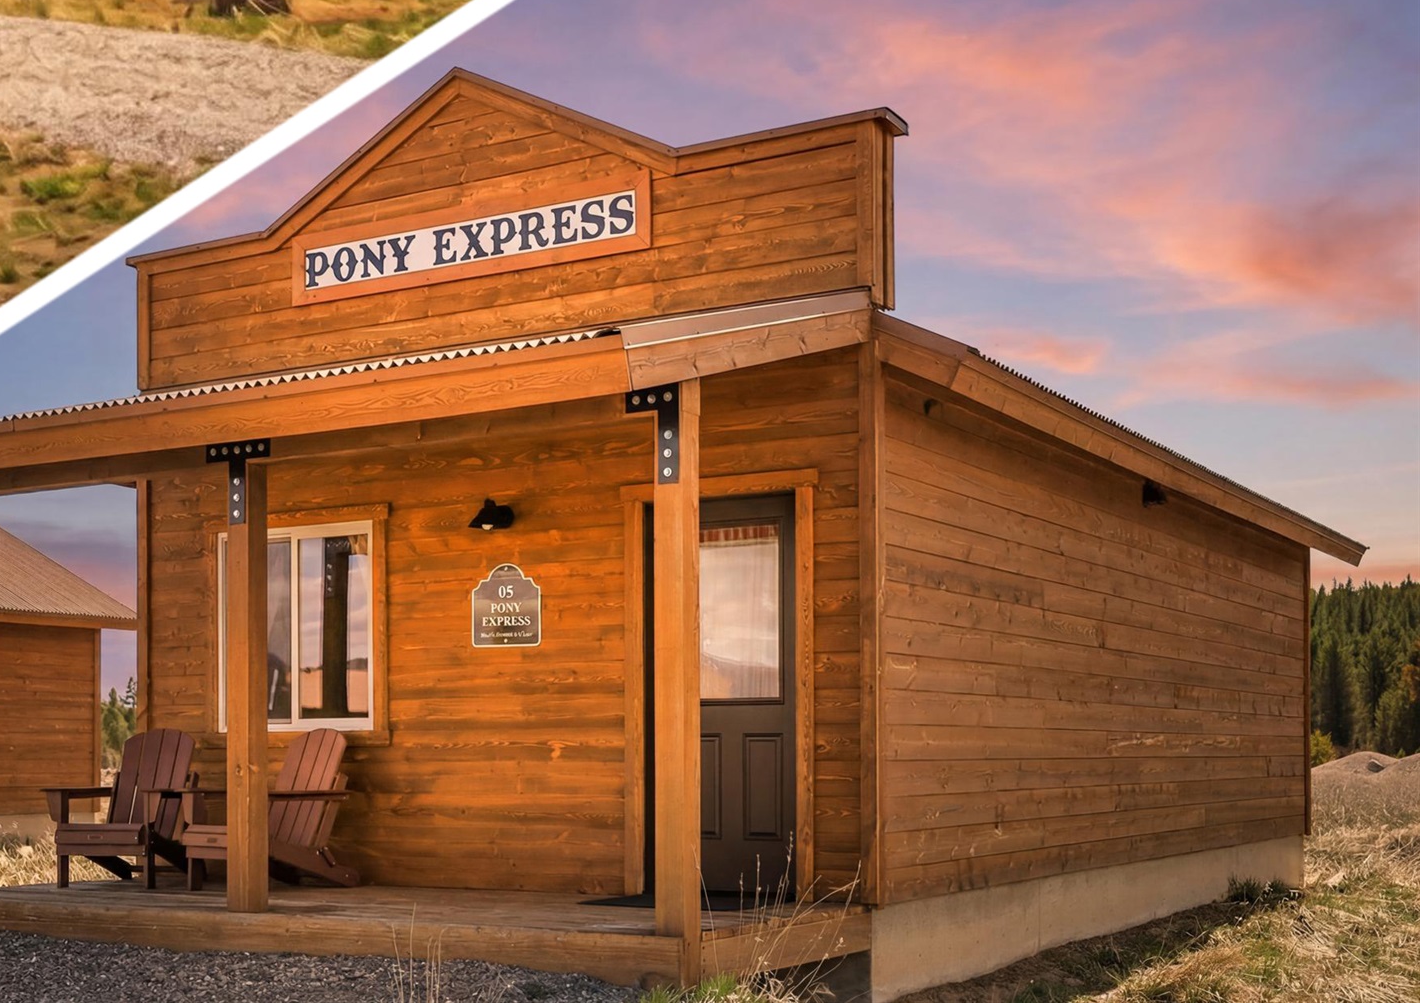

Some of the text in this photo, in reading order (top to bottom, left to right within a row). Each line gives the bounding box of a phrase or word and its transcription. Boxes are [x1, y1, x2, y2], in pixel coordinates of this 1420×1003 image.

[306, 194, 635, 288] PONY EXPRESS
[498, 585, 514, 599] 05
[490, 602, 522, 614] PONY
[482, 615, 531, 627] EXPRESS
